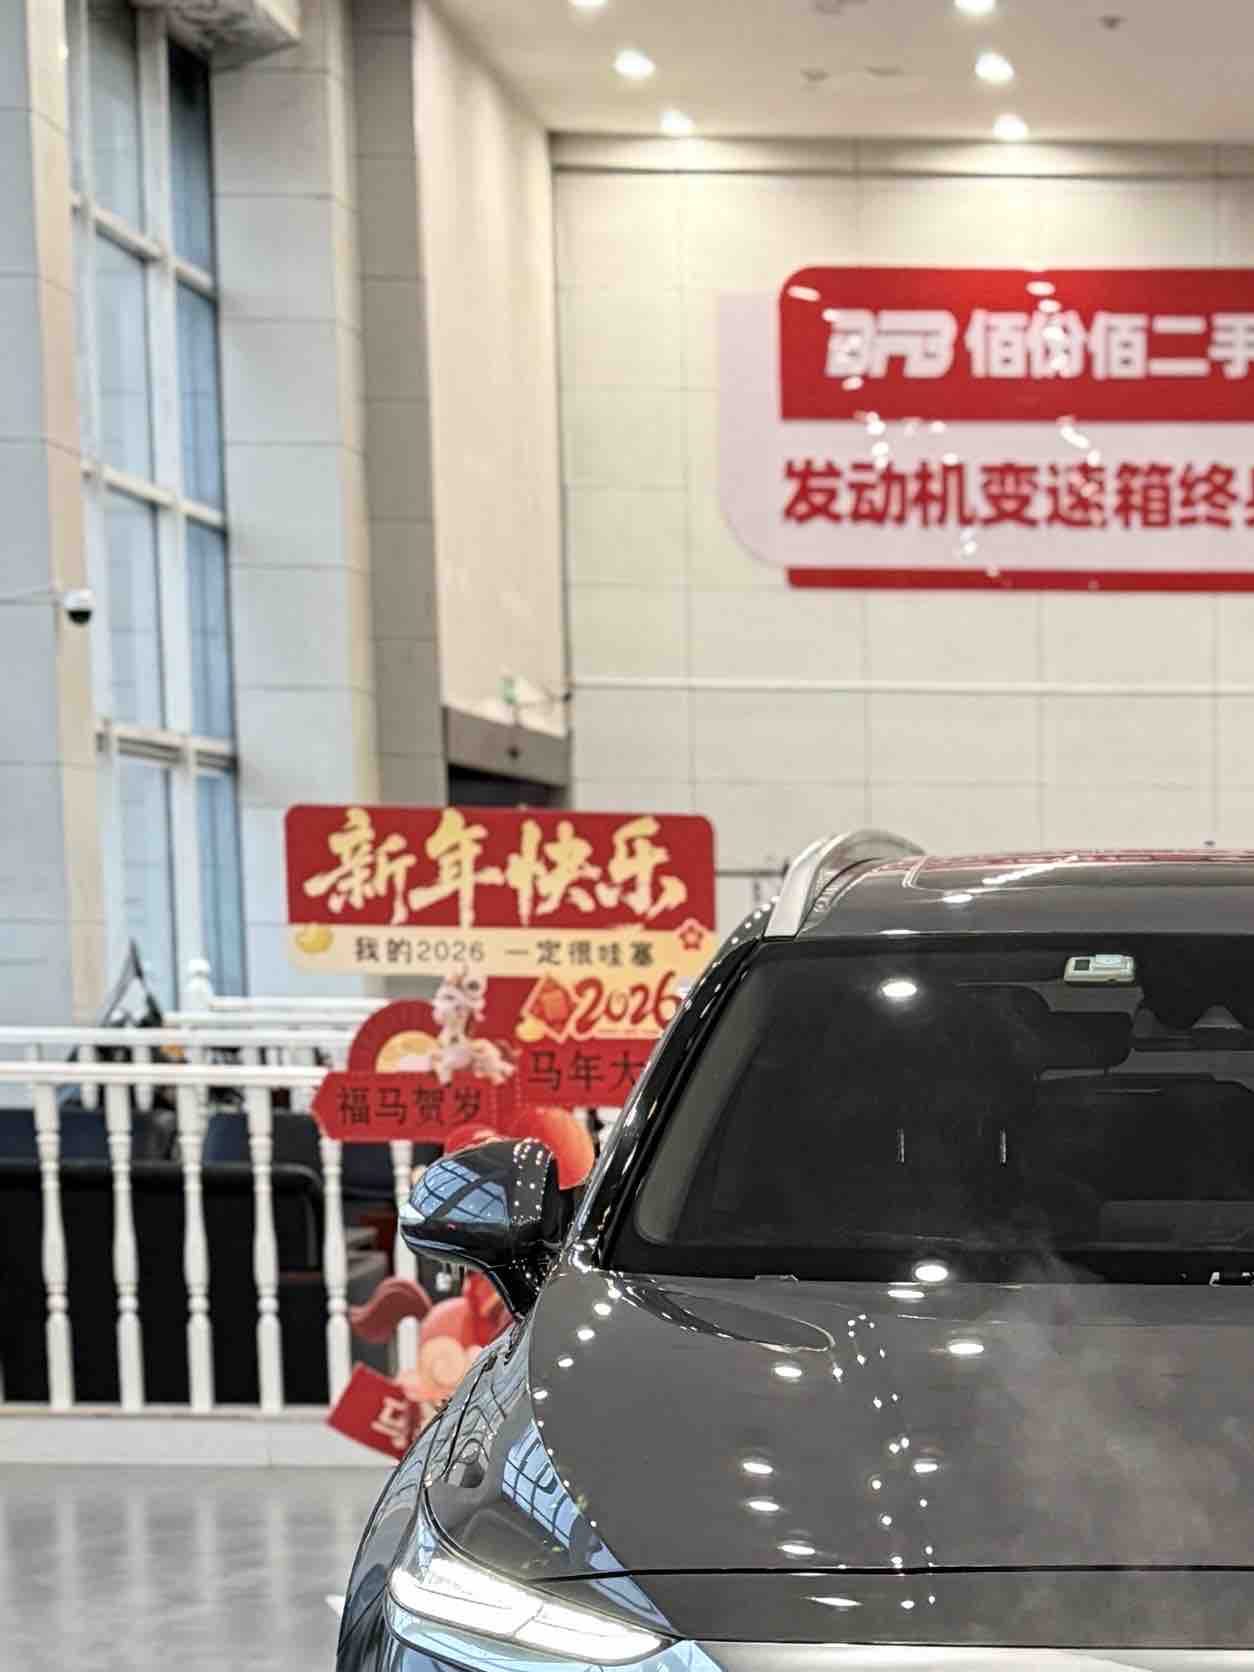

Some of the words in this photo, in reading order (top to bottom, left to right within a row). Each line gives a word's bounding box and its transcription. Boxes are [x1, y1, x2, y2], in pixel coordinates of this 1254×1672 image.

[303, 807, 688, 928] 新年快乐
[354, 936, 486, 964] 我的2026
[504, 940, 655, 967] 一定很哇塞
[574, 970, 681, 1034] 2026
[336, 1086, 482, 1126] 福马贺岁
